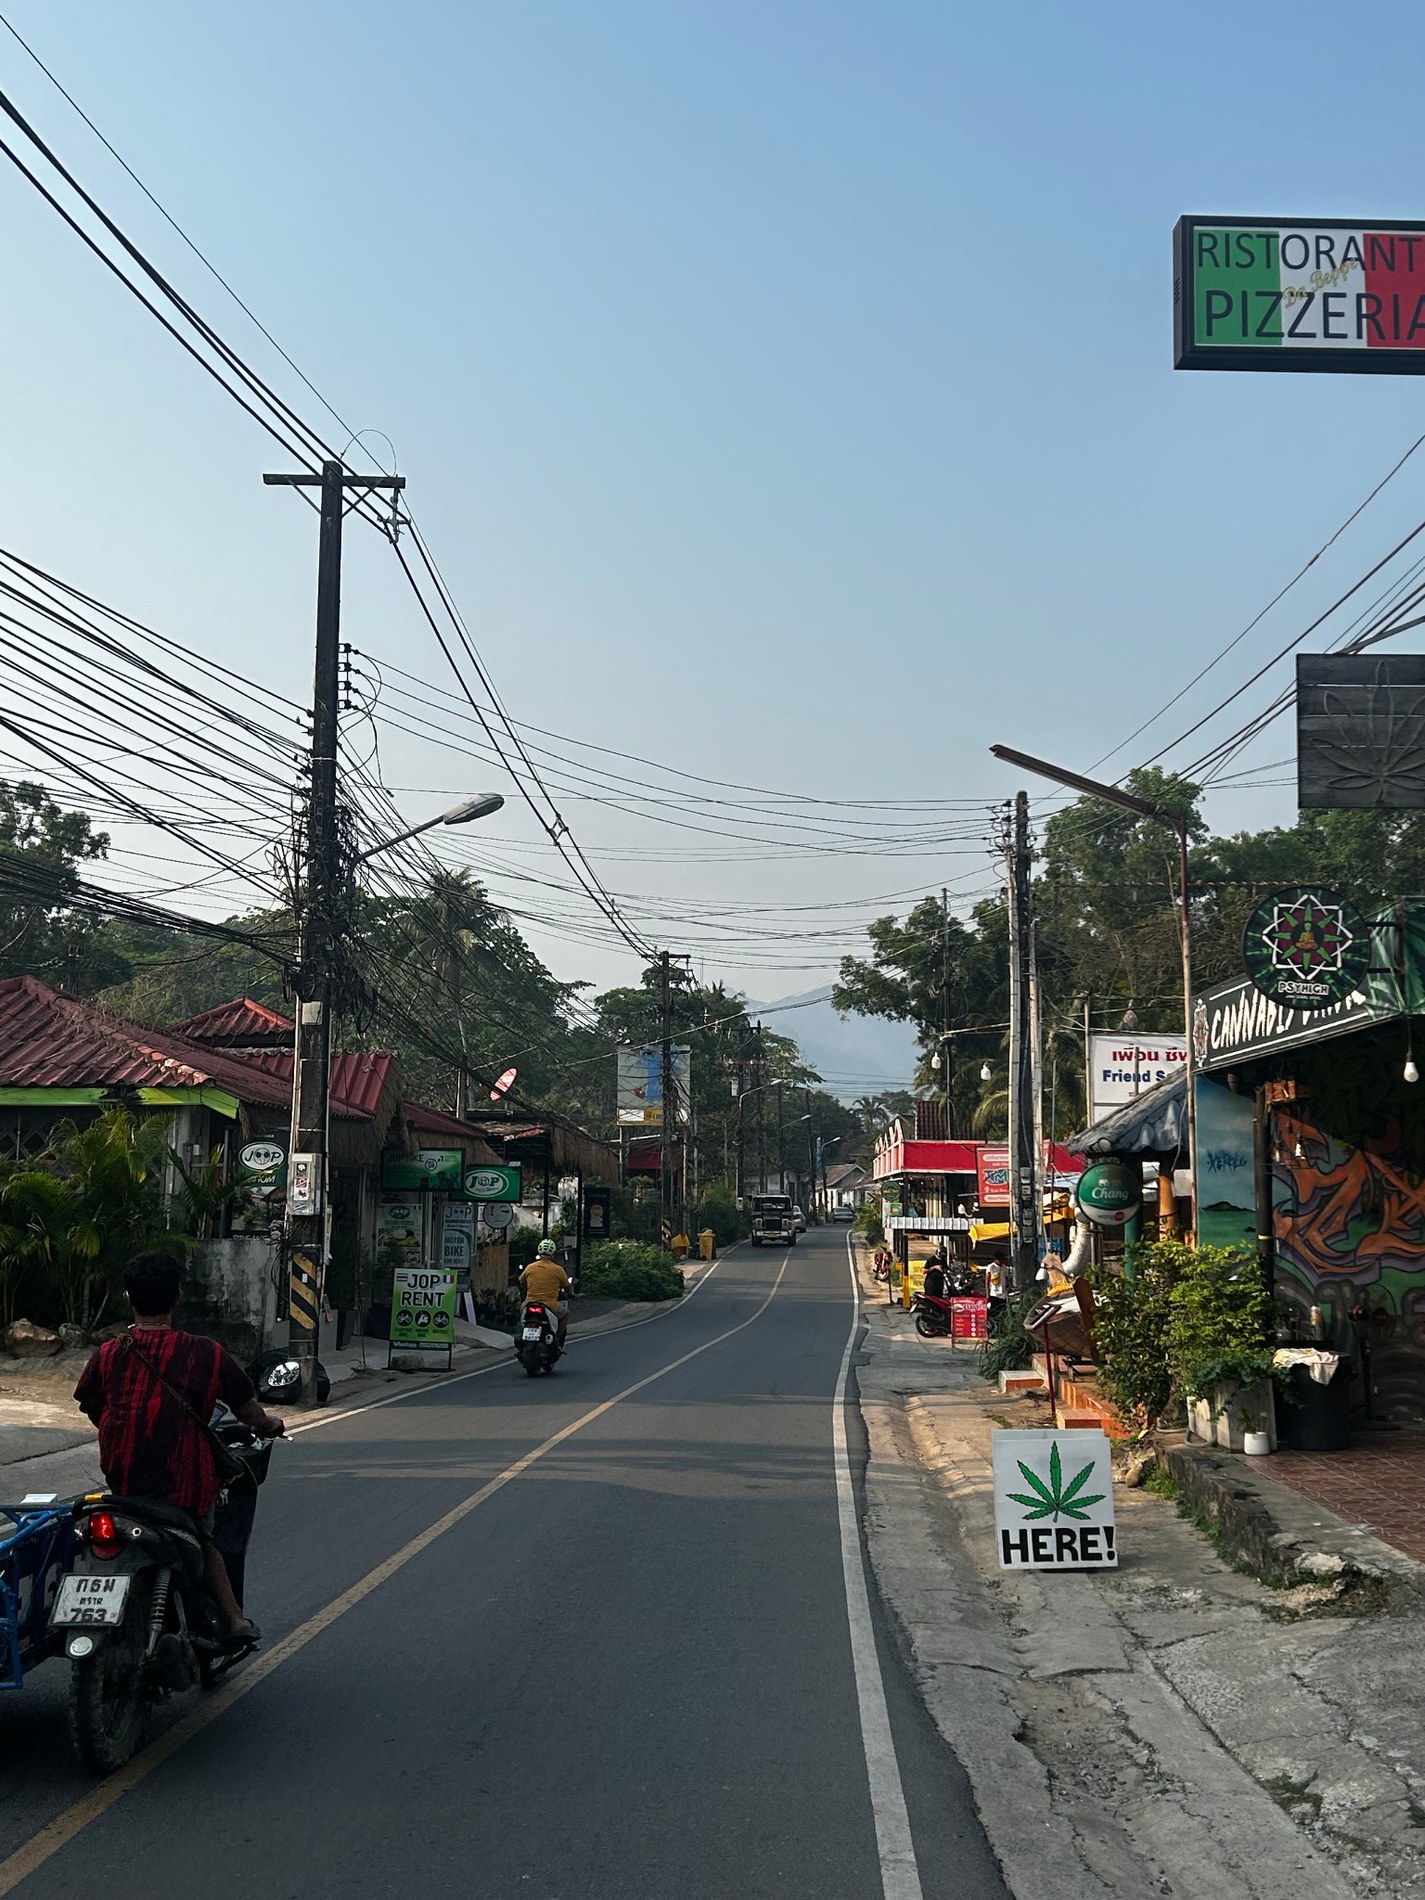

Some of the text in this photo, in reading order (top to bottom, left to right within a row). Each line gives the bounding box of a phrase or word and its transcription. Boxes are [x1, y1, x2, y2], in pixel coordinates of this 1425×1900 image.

[1198, 232, 1422, 272] RISTORANT
[1278, 982, 1330, 995] PSYHIGH
[1103, 1069, 1151, 1082] Friend
[1092, 1187, 1129, 1200] Chang
[444, 1246, 464, 1256] BIKE
[407, 1274, 440, 1289] JOP
[402, 1291, 445, 1307] RENT
[1002, 1526, 1115, 1564] HERE!
[70, 1608, 107, 1623] 763
